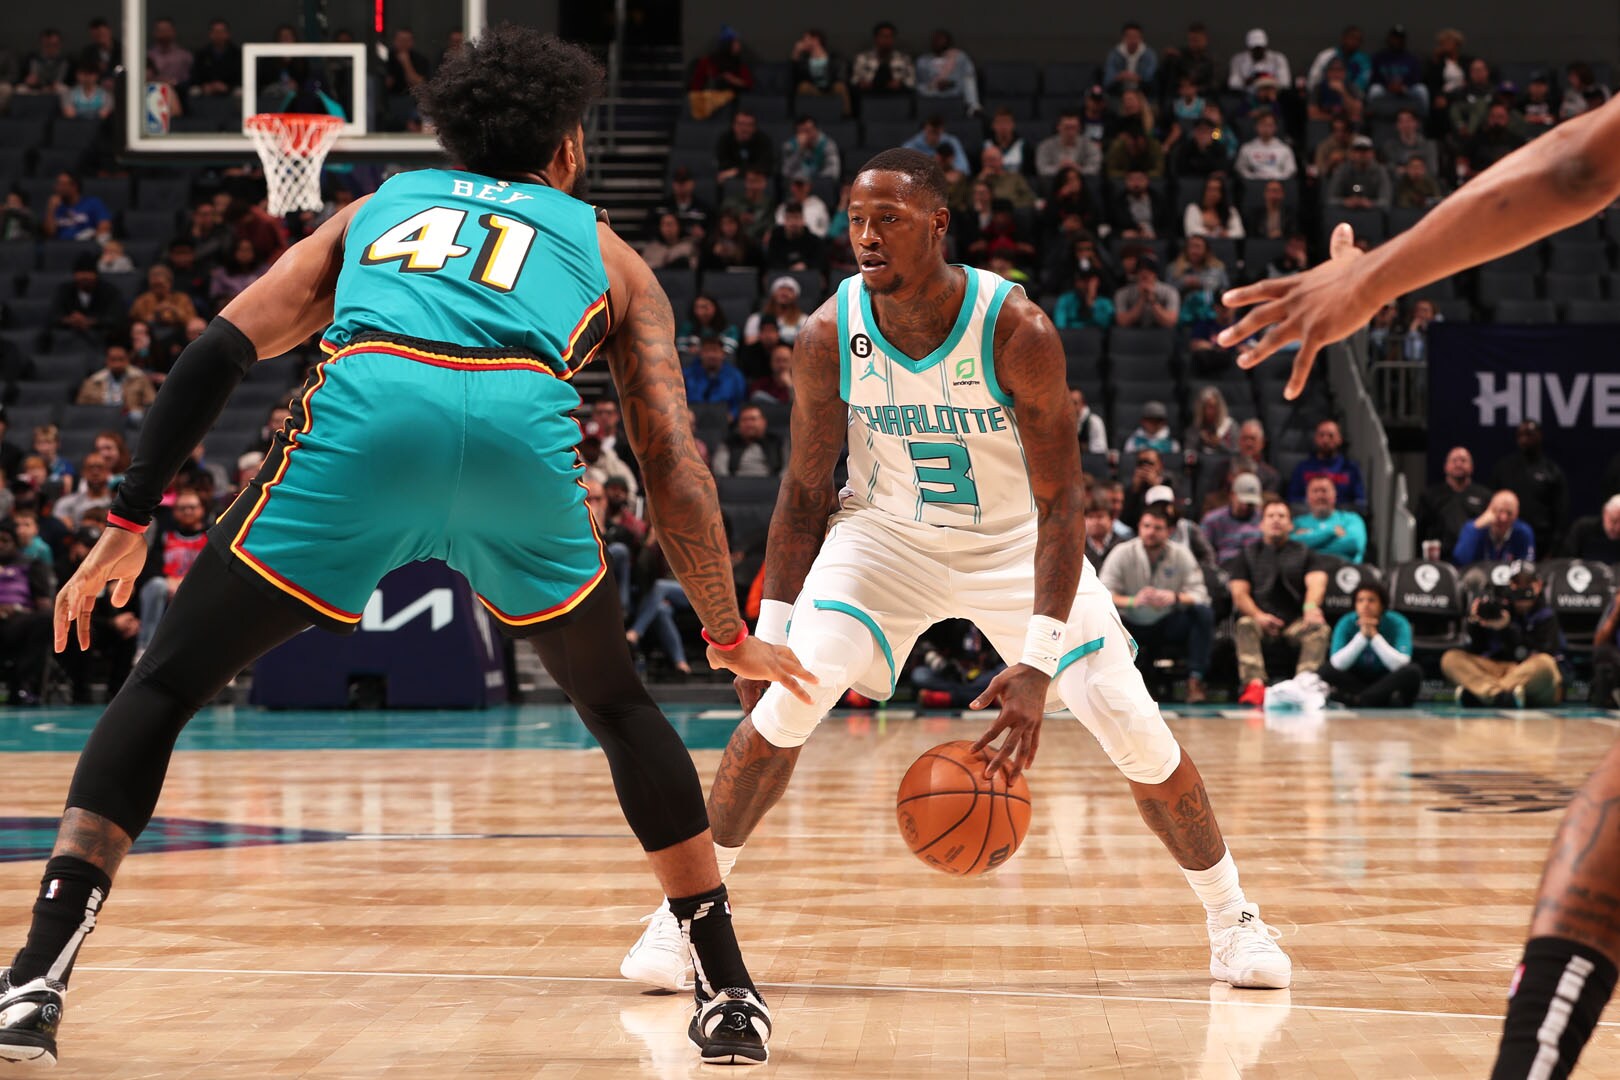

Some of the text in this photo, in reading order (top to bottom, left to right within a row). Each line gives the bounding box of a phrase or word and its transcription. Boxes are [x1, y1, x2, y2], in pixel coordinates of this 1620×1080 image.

[451, 179, 535, 204] BEY
[359, 205, 538, 294] 41
[855, 337, 868, 356] 6
[1472, 371, 1620, 428] HIVE
[908, 441, 979, 506] 3
